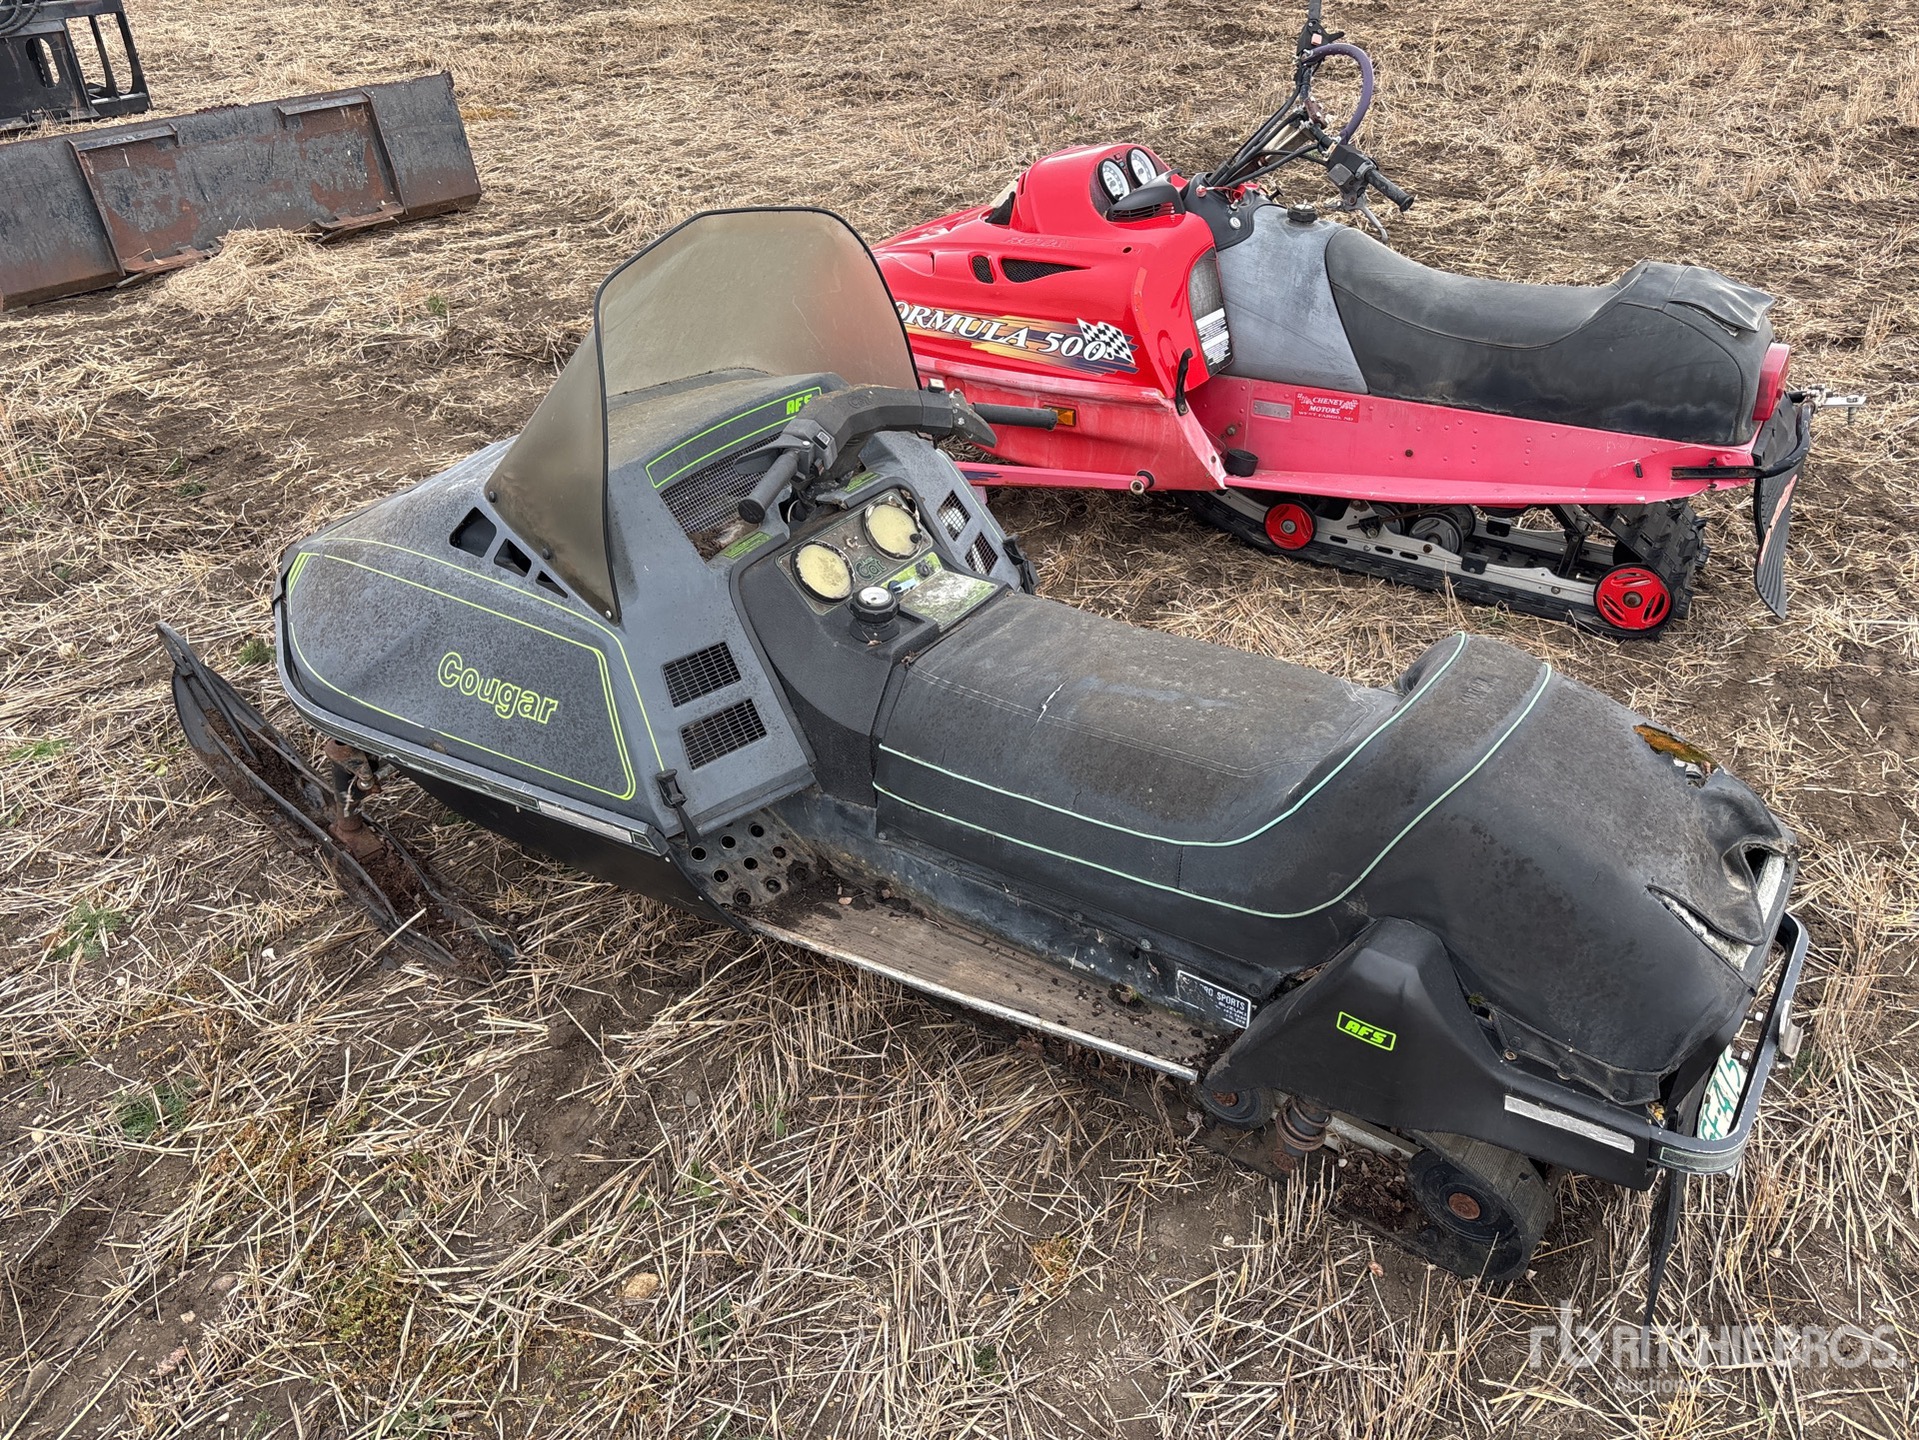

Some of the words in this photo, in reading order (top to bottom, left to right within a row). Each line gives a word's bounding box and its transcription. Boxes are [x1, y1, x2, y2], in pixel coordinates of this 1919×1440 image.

[895, 301, 1028, 349] ORMULA
[1038, 332, 1108, 362] 500
[1309, 405, 1340, 415] MOTORS
[1312, 397, 1344, 406] CHENEY
[438, 652, 558, 724] Cougar
[1217, 991, 1245, 1011] SPORTS
[1345, 1020, 1387, 1043] AFS
